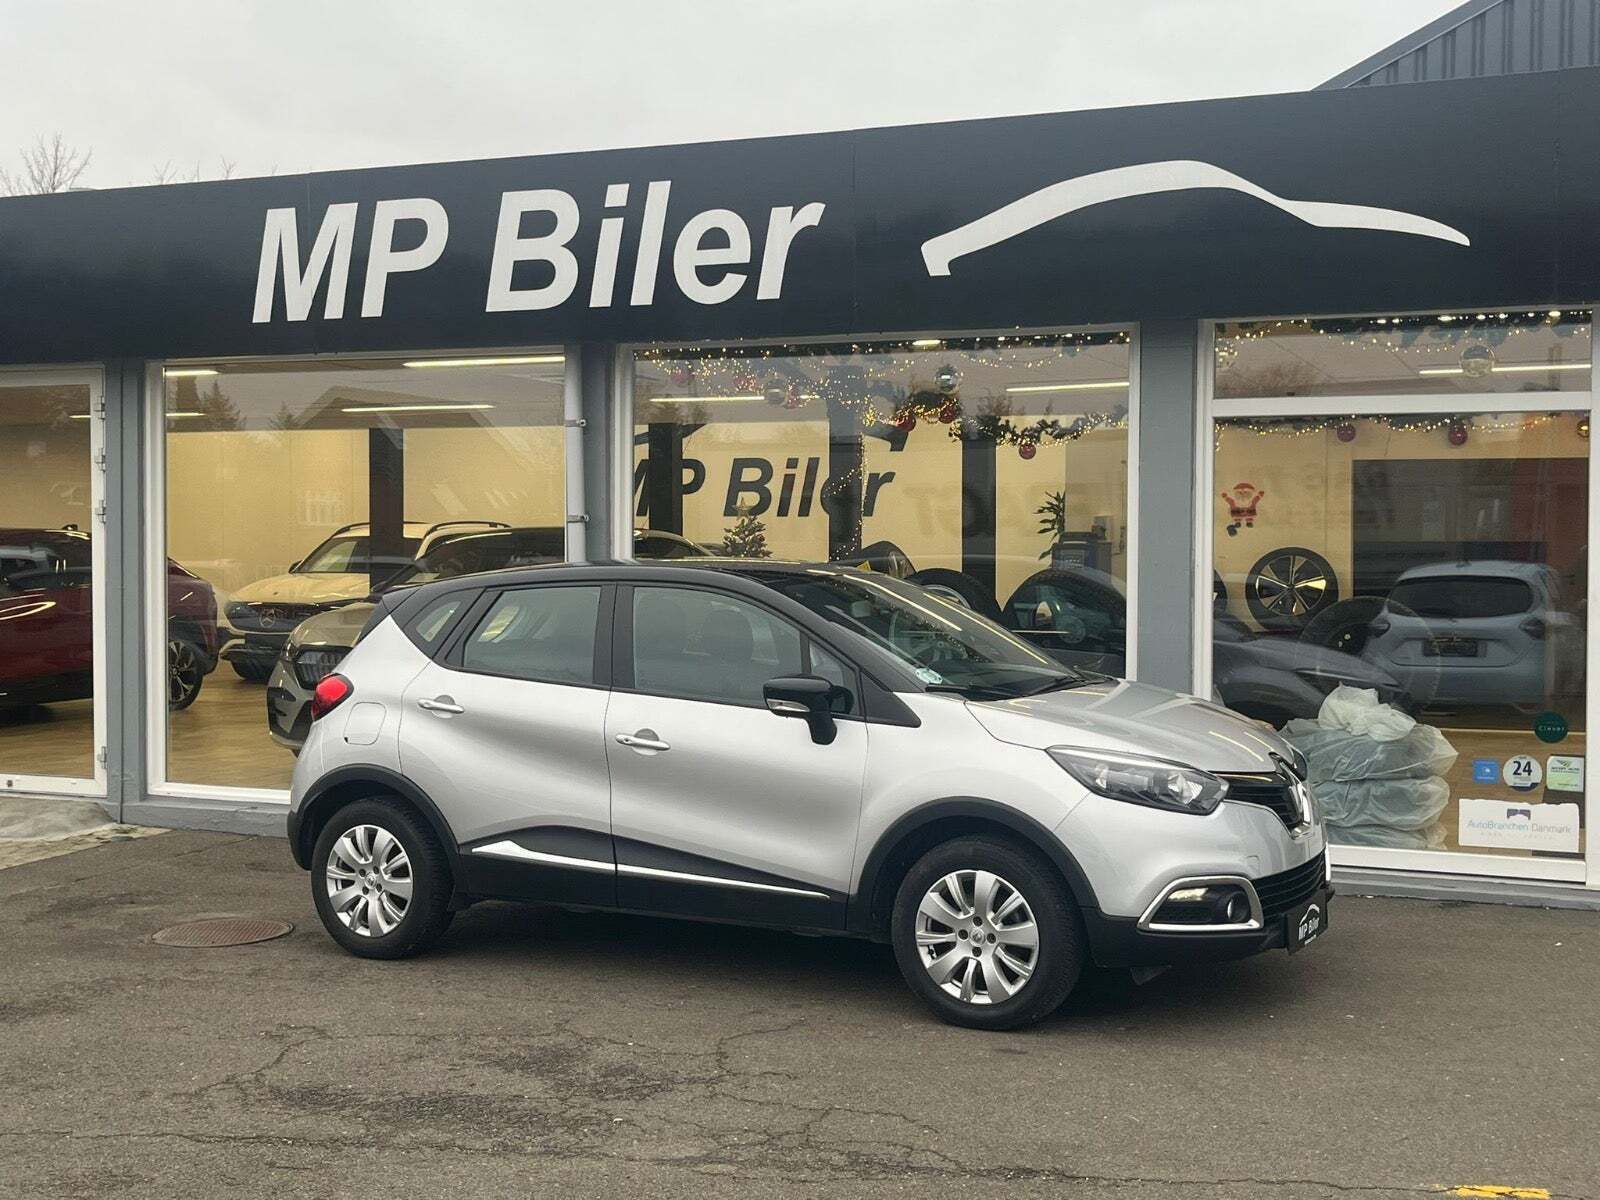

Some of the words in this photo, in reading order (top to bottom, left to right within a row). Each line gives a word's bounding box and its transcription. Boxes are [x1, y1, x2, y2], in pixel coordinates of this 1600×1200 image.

[252, 197, 449, 324] MP
[485, 180, 827, 313] Biler
[723, 457, 896, 518] Bilr
[1512, 760, 1533, 777] 24
[1531, 823, 1571, 834] Danmark
[1298, 923, 1308, 941] MP
